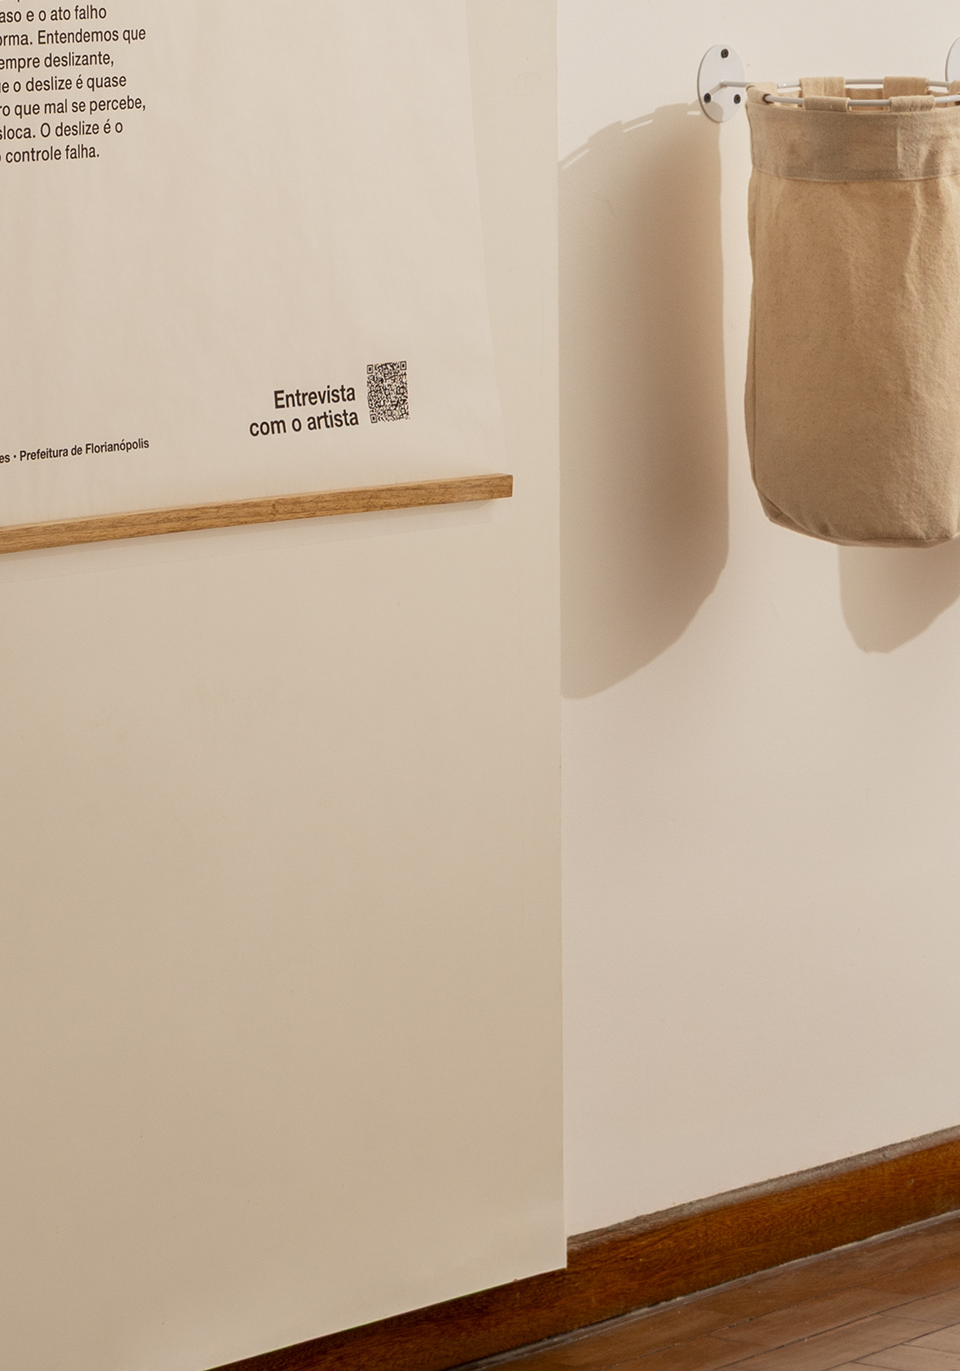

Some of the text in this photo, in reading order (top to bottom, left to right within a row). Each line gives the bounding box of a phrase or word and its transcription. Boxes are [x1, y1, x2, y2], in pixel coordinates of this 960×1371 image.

[74, 4, 107, 20] falho
[37, 27, 120, 45] Entendemos
[43, 50, 114, 68] deslizante,
[25, 75, 127, 93] deslize quase
[89, 94, 146, 116] percebe,
[54, 120, 100, 138] deslize
[5, 143, 100, 164] controle falha.
[273, 384, 356, 410] Entrevista
[249, 408, 360, 437] com o artista
[19, 447, 69, 462] Prefeitura
[70, 444, 83, 457] de
[85, 437, 150, 455] Florianópolis
